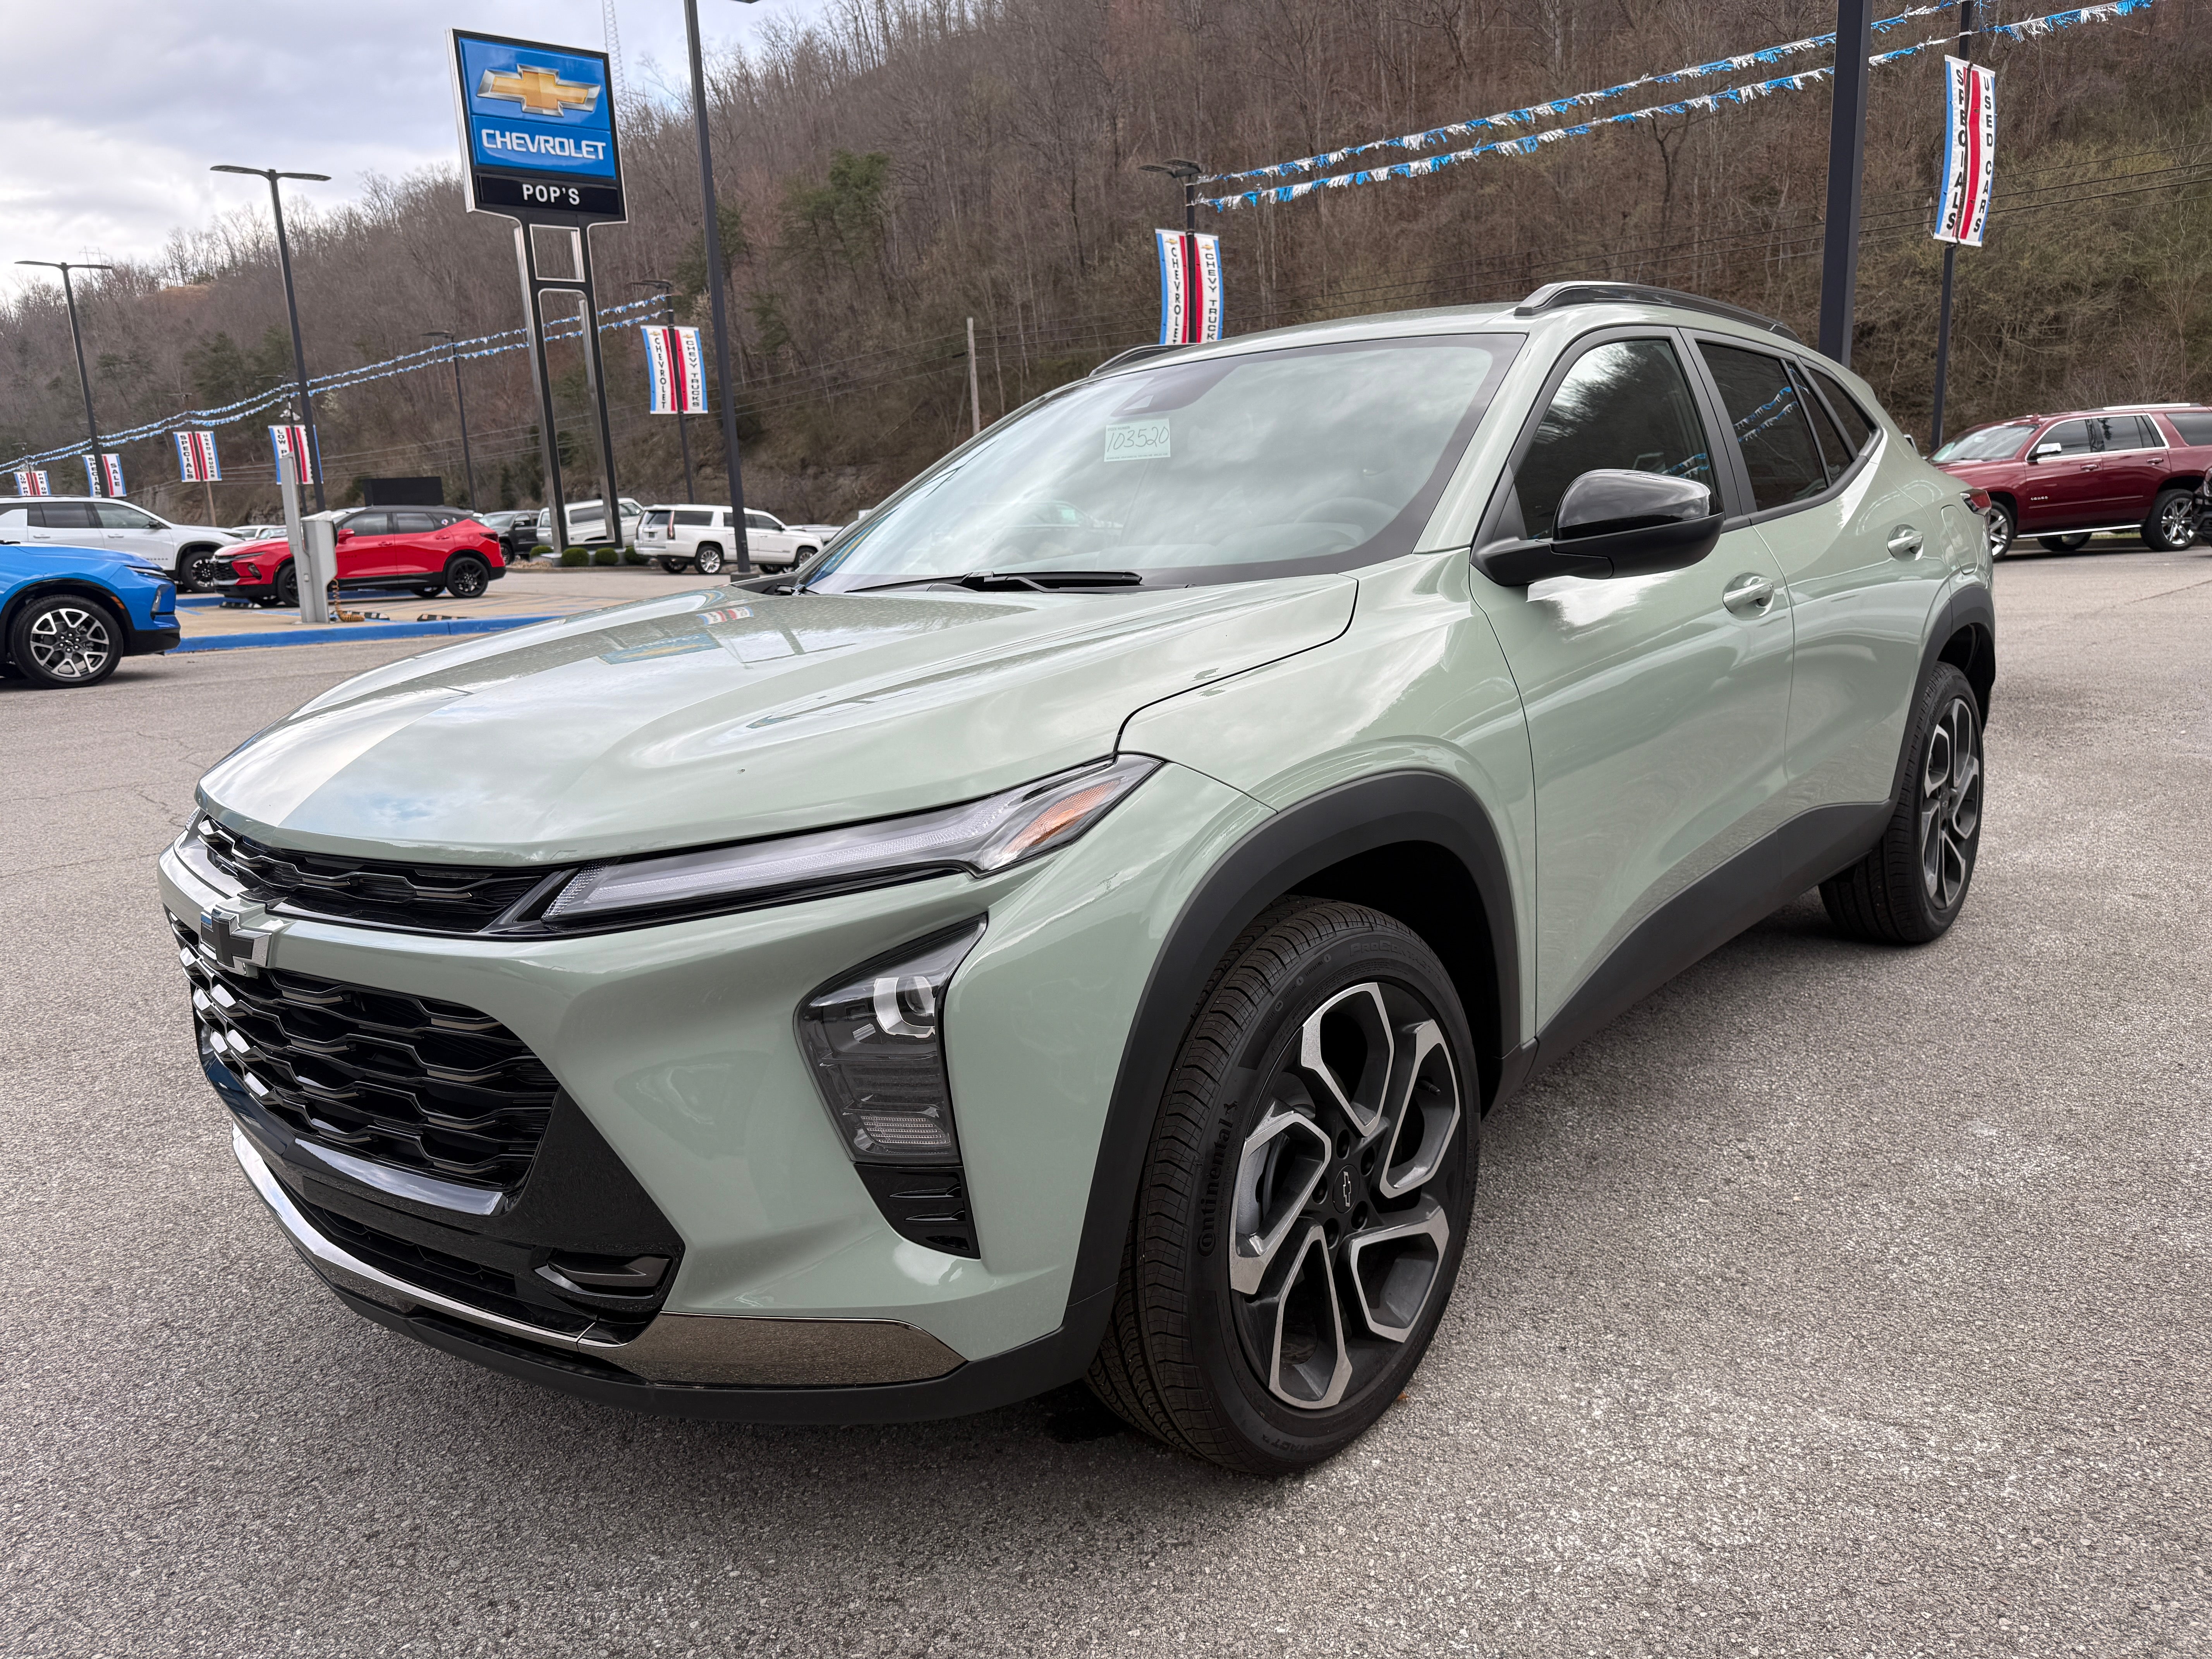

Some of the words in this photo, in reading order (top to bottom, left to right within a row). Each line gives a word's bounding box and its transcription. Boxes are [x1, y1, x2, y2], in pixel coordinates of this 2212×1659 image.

[1983, 76, 1993, 147] USED
[481, 128, 606, 160] CHEVROLET
[522, 183, 580, 206] POP'S
[1973, 161, 1992, 233] CARS
[1205, 253, 1217, 293] CHEVY
[1206, 299, 1217, 342] TRUCK
[654, 338, 667, 409] CHEVROLET
[686, 340, 697, 368] CHEVY
[691, 373, 700, 407] TRUCKS
[277, 429, 286, 445] LOW
[1107, 426, 1170, 453] 103520
[88, 457, 101, 496] SPECIALS
[110, 463, 120, 487] SALE
[180, 435, 194, 479] SPECIALS
[1197, 1118, 1233, 1257] Continental
